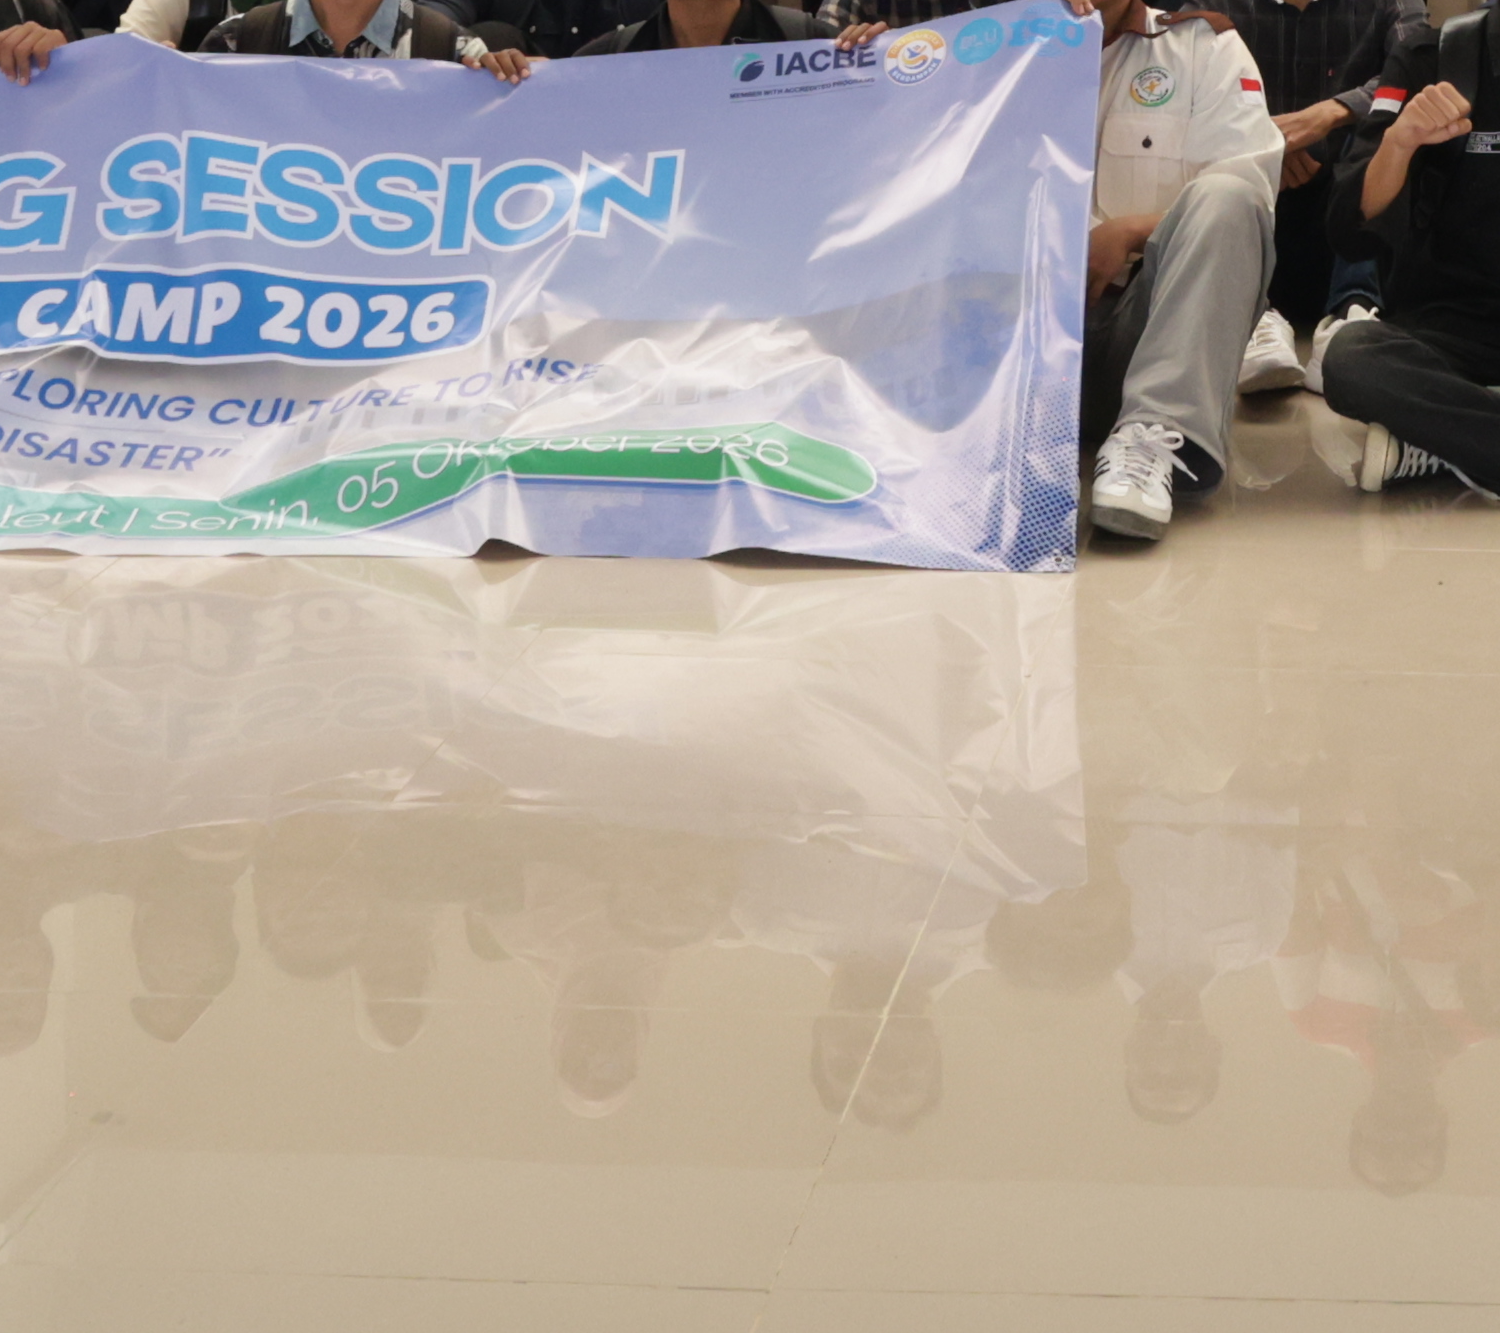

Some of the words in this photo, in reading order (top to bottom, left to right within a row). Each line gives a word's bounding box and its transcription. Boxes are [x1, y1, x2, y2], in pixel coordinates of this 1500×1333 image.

[775, 45, 877, 77] IACBE
[1008, 17, 1086, 48] ISO
[100, 133, 683, 253] SESSION
[16, 280, 239, 348] CAMP
[260, 286, 455, 349] 2026
[208, 383, 421, 427] CULTURE
[433, 372, 493, 402] TO
[502, 356, 606, 388] RISE
[337, 461, 400, 513] 05
[649, 433, 791, 468] 2026
